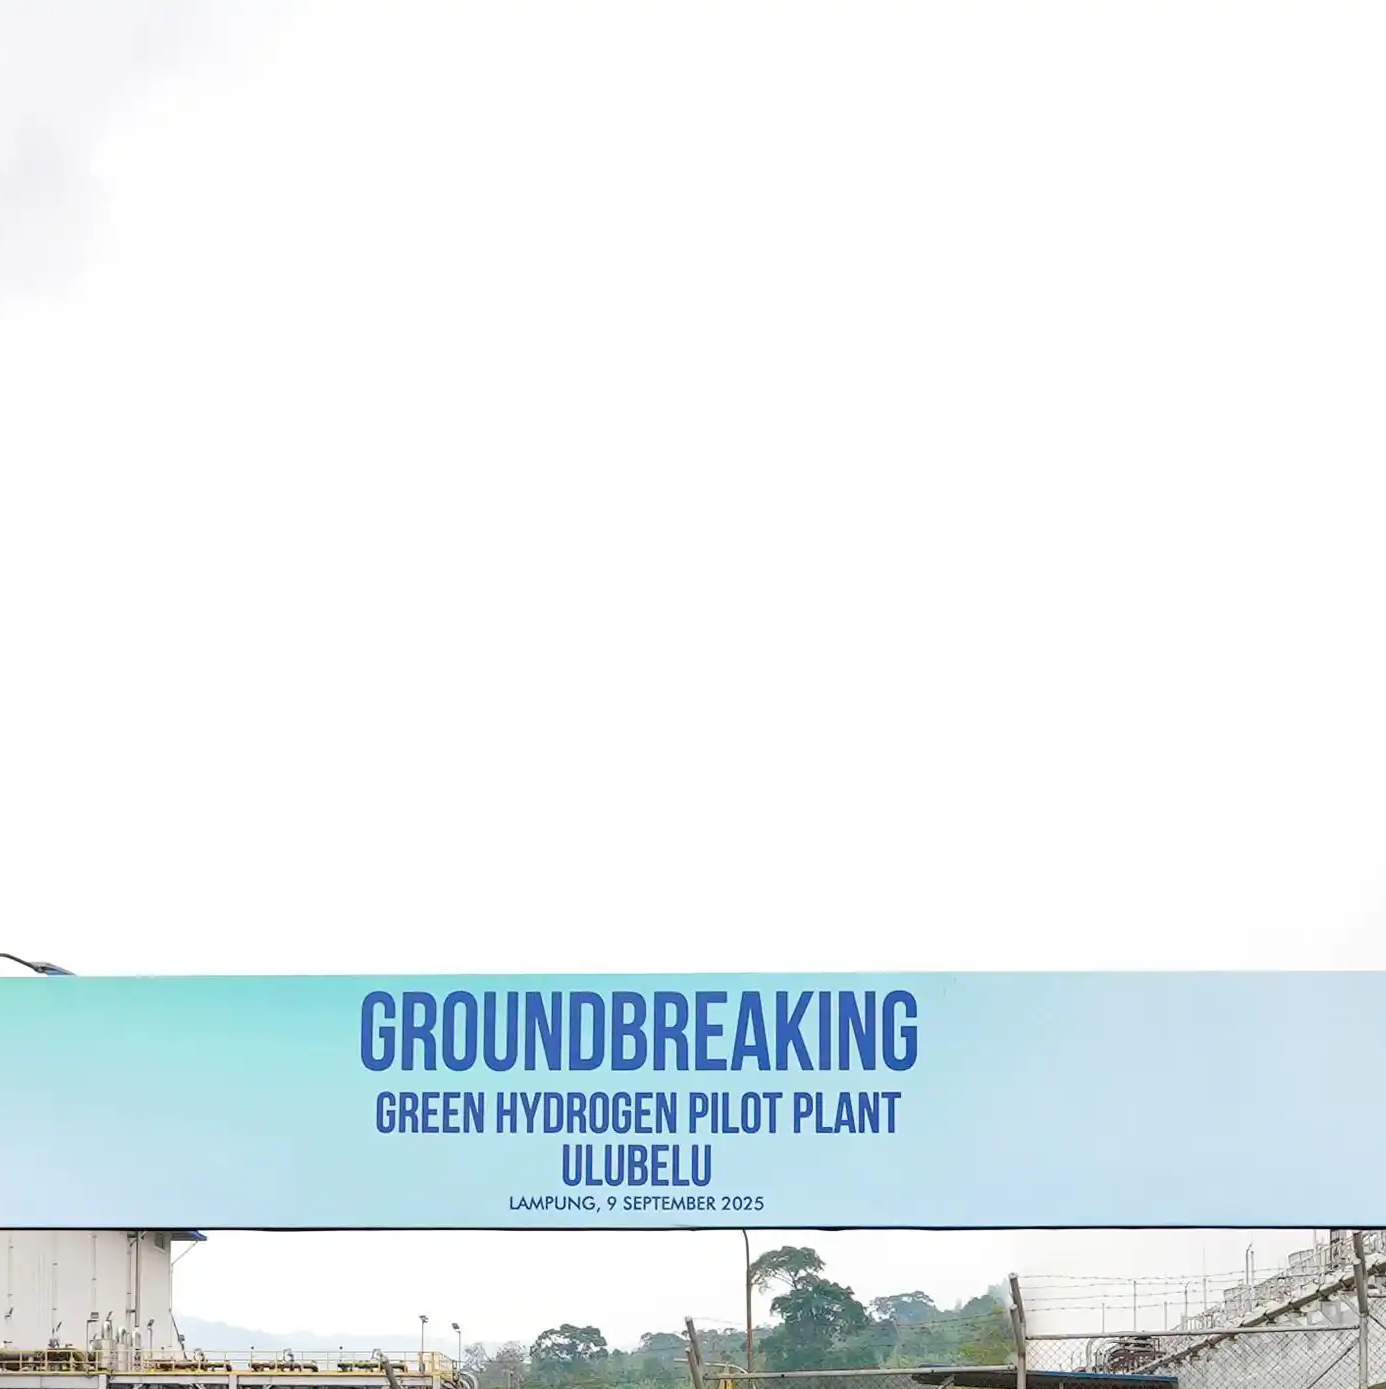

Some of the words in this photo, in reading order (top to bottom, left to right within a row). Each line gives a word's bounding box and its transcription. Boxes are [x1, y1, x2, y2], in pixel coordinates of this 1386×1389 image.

[360, 990, 918, 1072] GROUNDBREAKING
[375, 1090, 486, 1135] GREEN
[495, 1090, 678, 1135] HYDROGEN
[688, 1090, 784, 1135] PILOT
[793, 1090, 902, 1135] PLANT
[561, 1143, 712, 1188] ULUBELU
[509, 1195, 601, 1213] LAMPUNG,
[606, 1195, 618, 1211] 9
[622, 1195, 716, 1212] SEPTEMBER
[720, 1195, 765, 1211] 2025
